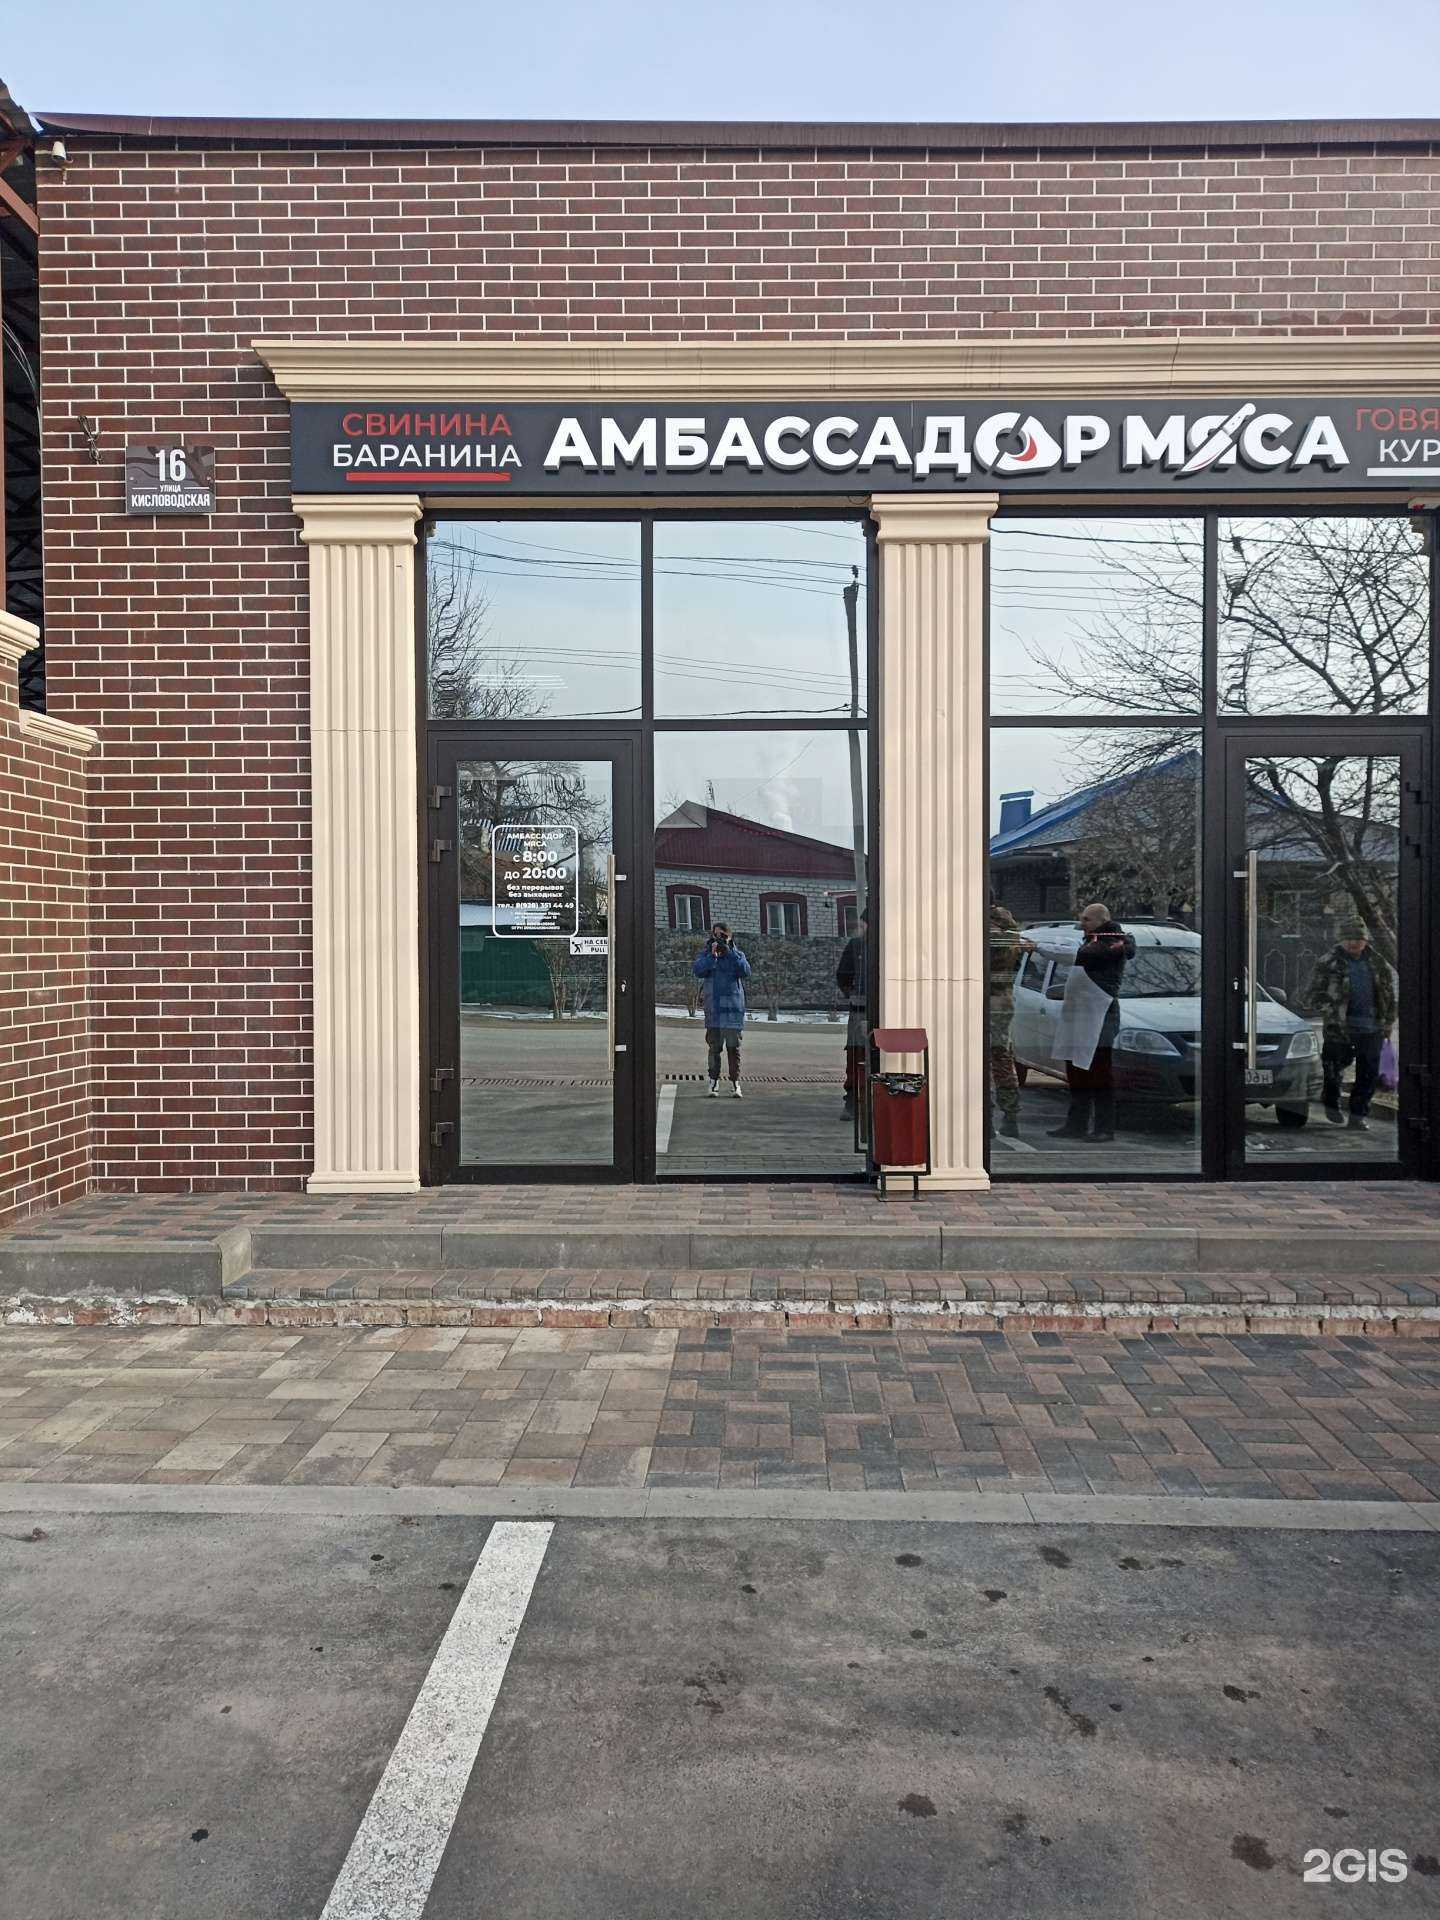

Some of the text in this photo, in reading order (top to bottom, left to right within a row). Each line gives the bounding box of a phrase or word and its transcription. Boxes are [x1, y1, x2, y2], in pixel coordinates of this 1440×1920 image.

[342, 412, 513, 437] СВИНИНА
[543, 403, 1351, 479] АМБАССАДОР МЯСА
[155, 448, 186, 482] 16
[332, 443, 522, 468] БАРАНИНА
[160, 484, 181, 493] УЛИЦА
[131, 493, 211, 508] КИСЛОВОДСКАЯ
[522, 850, 558, 863] 8:00
[504, 867, 567, 880] до 20:00
